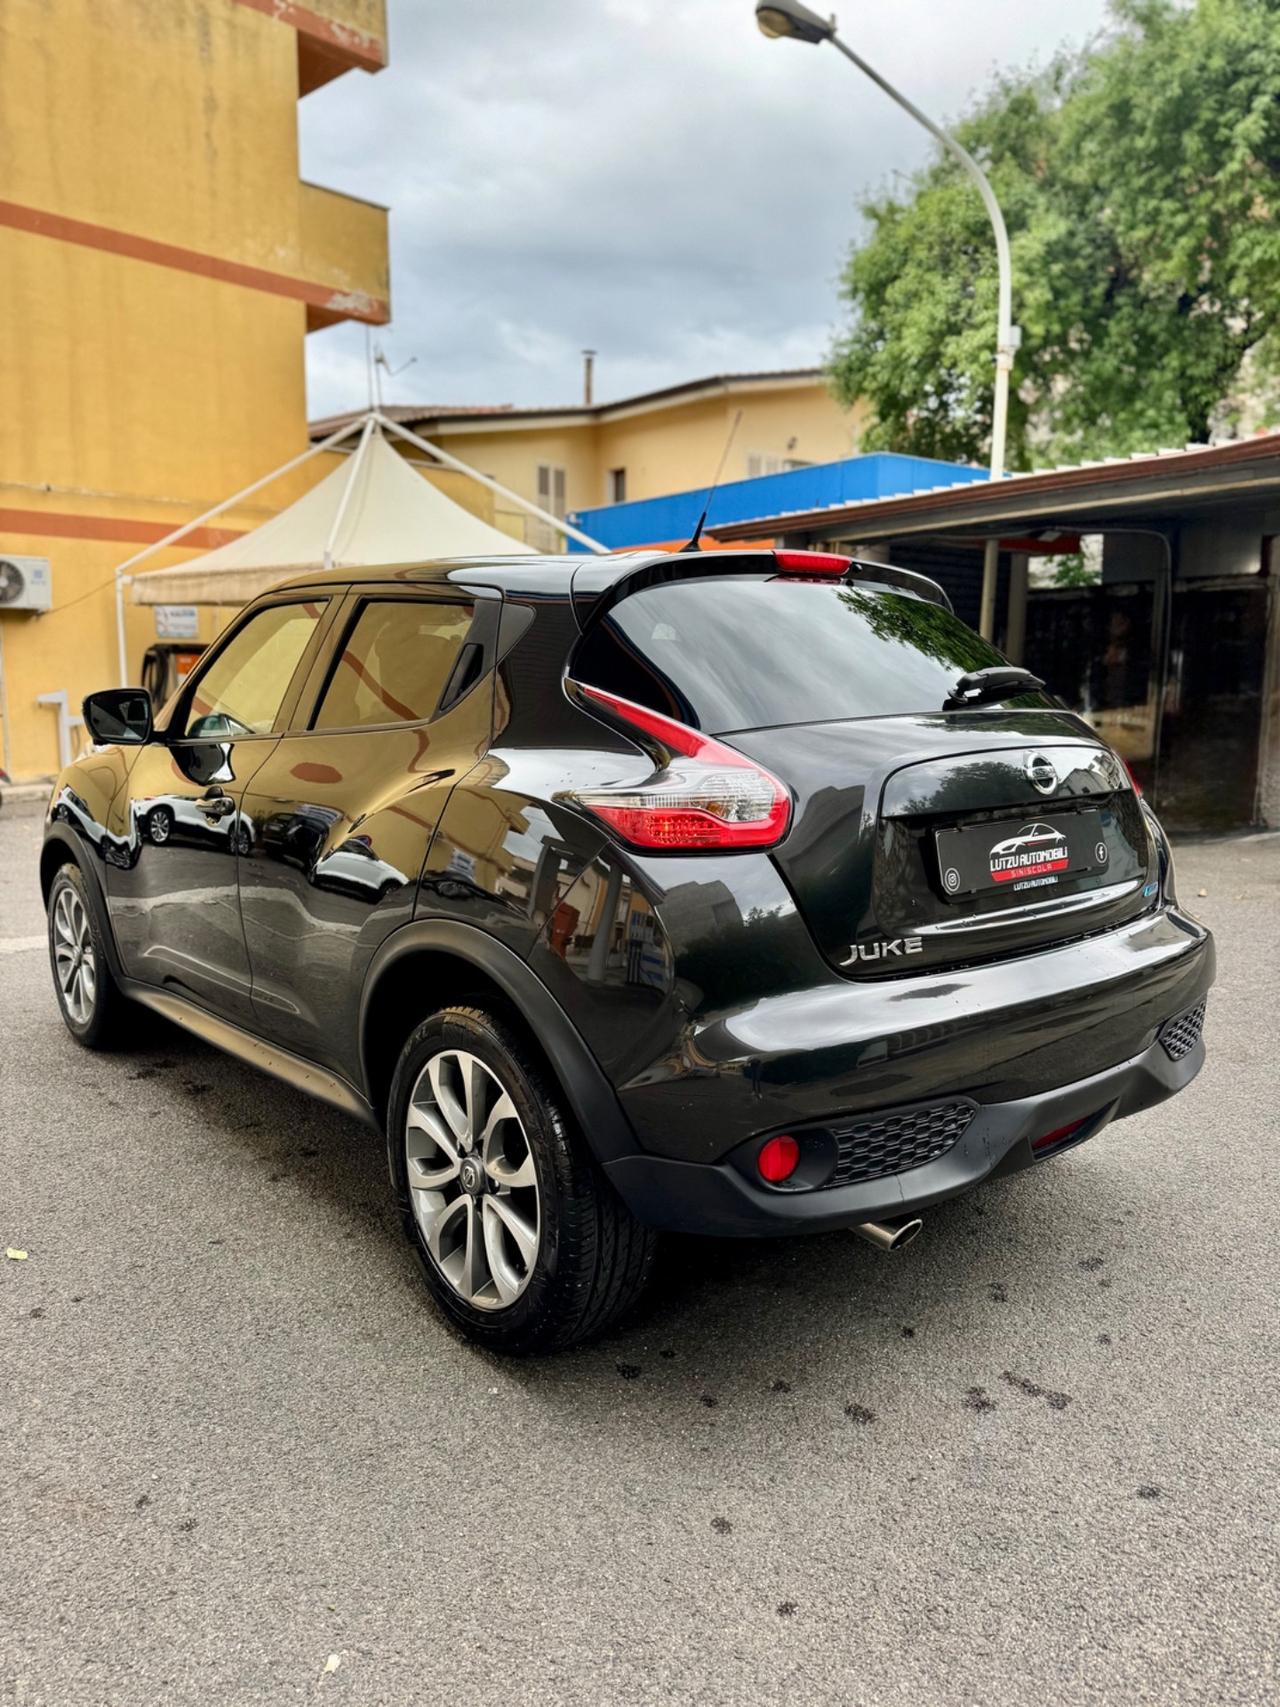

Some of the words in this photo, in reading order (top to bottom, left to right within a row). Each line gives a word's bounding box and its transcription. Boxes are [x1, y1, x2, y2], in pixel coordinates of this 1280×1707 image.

[990, 855, 1019, 872] LUTZU
[1020, 846, 1068, 867] AUTOMOBILI
[1010, 863, 1053, 879] SINISCOLA
[839, 936, 923, 967] JUKE
